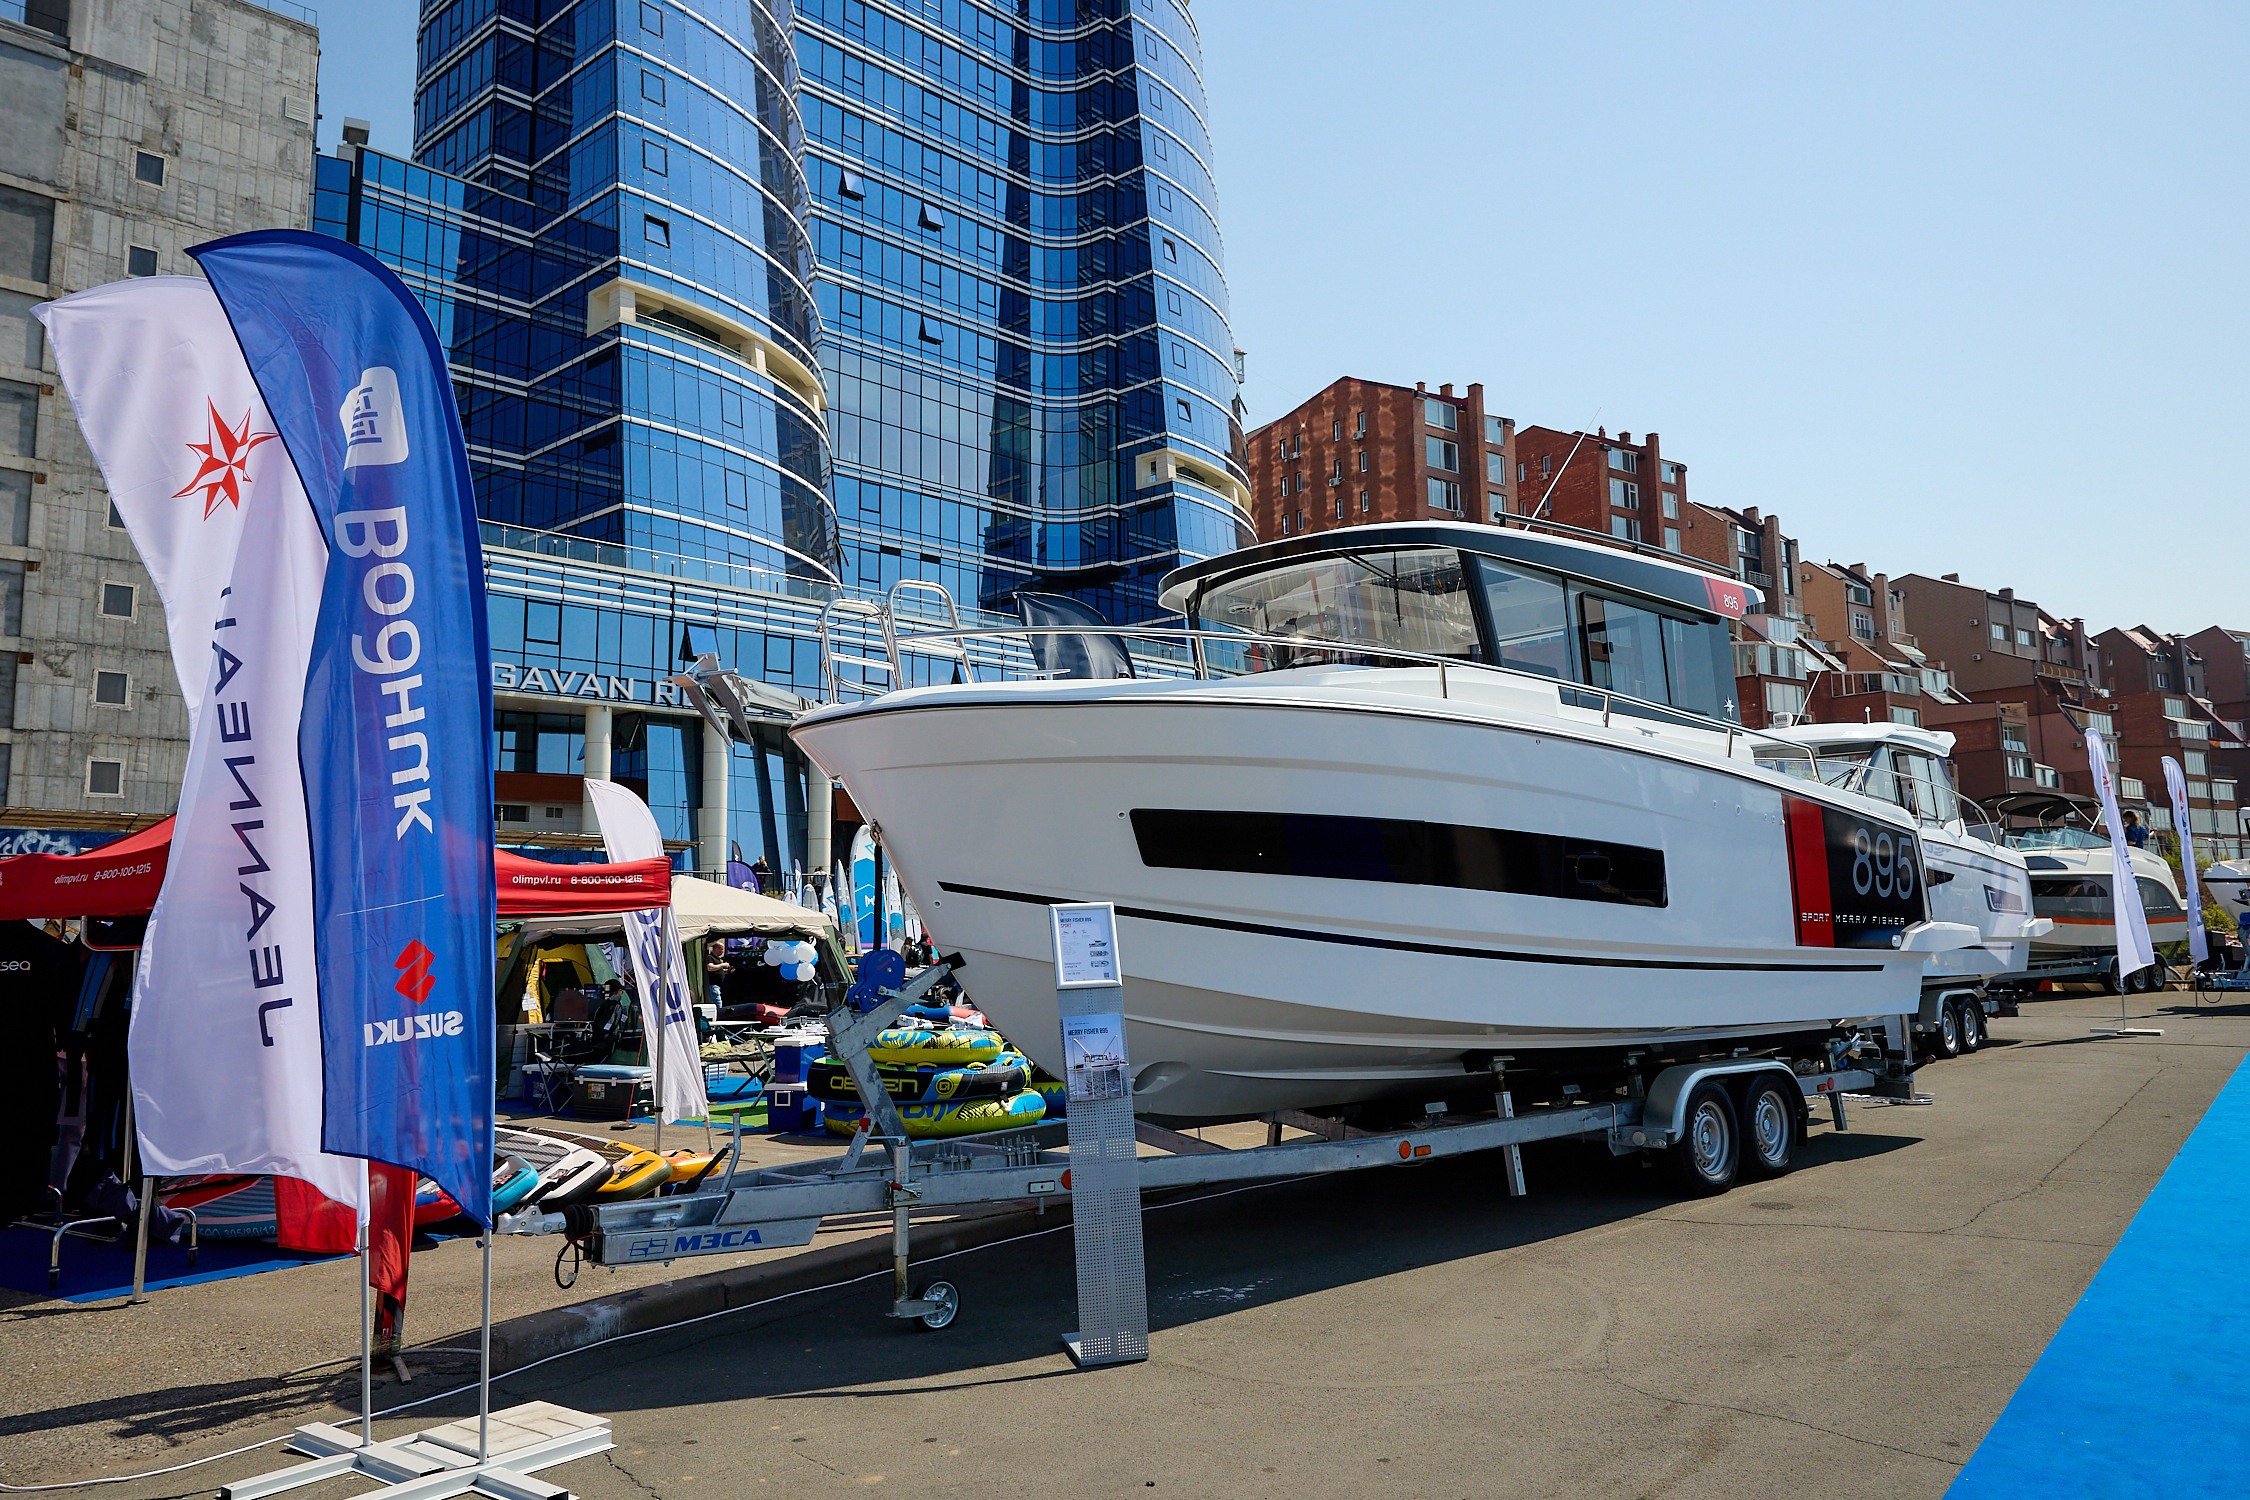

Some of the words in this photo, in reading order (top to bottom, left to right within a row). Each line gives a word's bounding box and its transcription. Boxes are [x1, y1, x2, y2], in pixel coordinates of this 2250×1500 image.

[1723, 593, 1739, 611] 895
[492, 662, 634, 700] GAVAN
[54, 873, 89, 885] olimpvl.ru
[93, 862, 152, 881] 8-800-100-1215
[1852, 828, 1913, 900] 895
[512, 874, 562, 886] olimpvl.ru
[570, 874, 643, 885] 8-800-100-1215
[1802, 912, 1830, 923] SPORT
[1835, 914, 1867, 924] MERRY
[1872, 915, 1905, 926] FISHER
